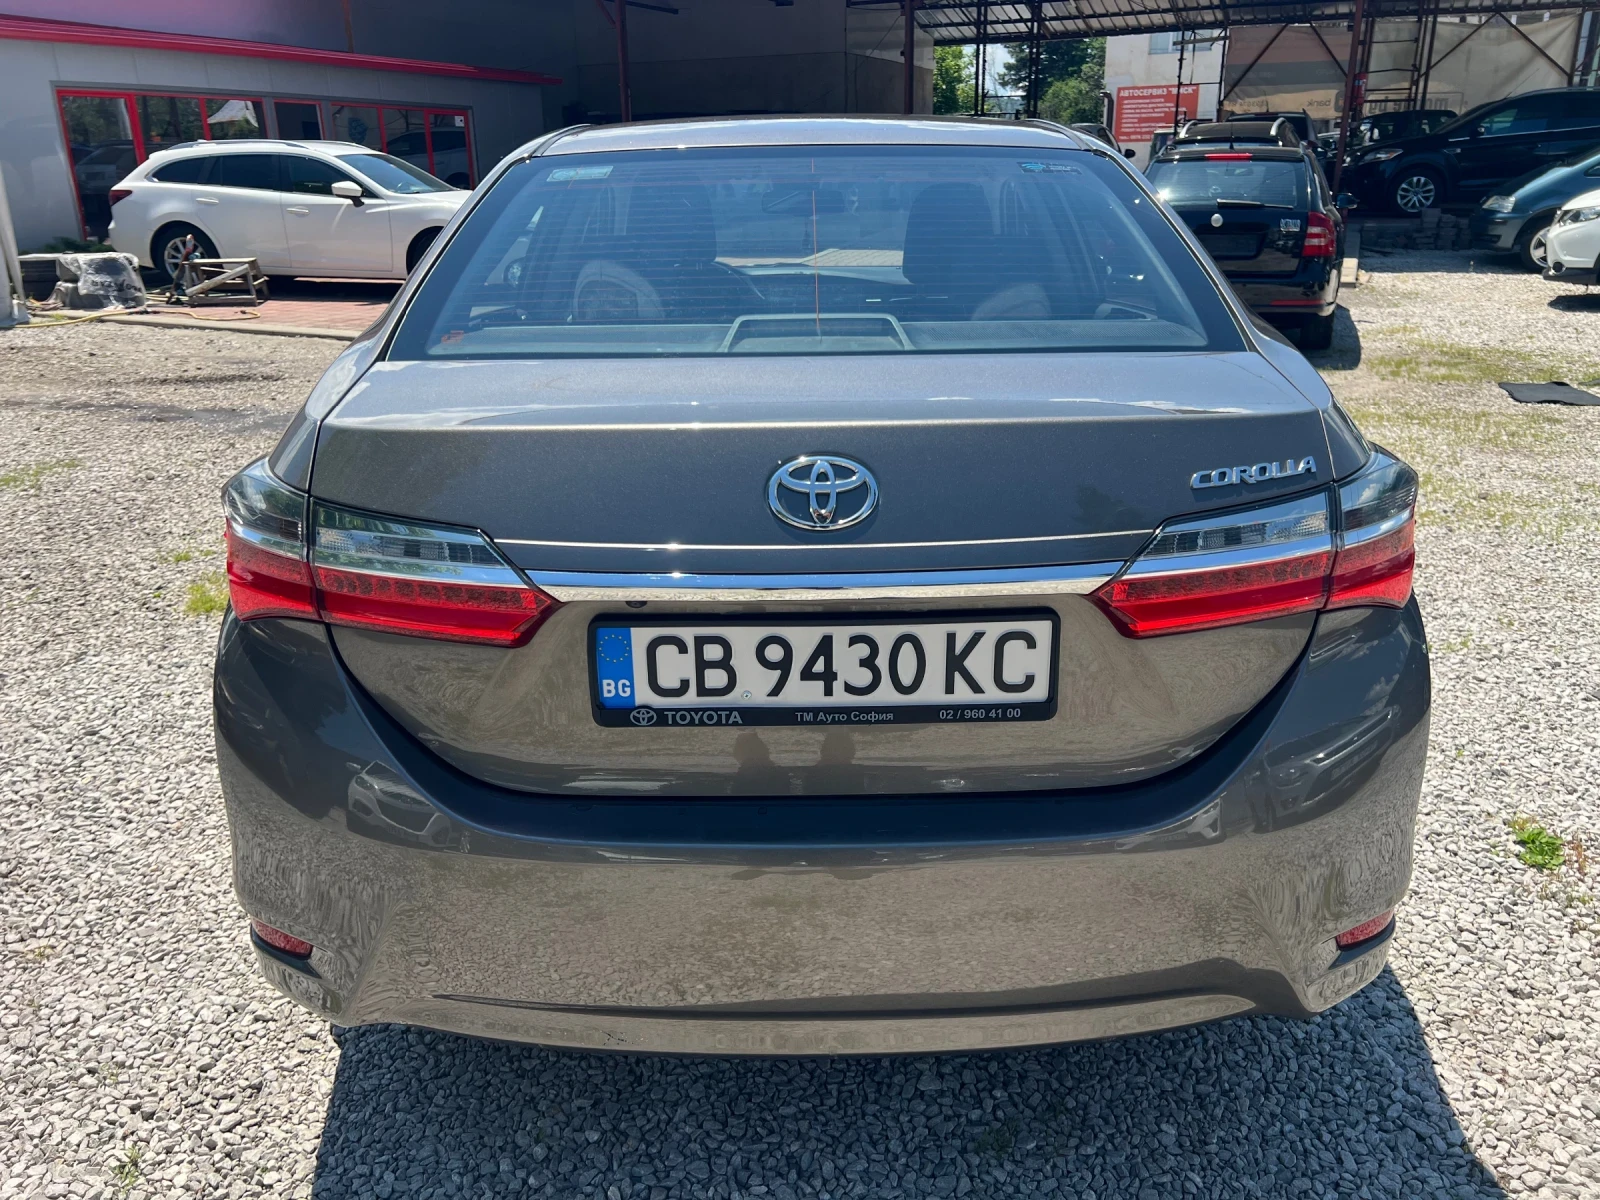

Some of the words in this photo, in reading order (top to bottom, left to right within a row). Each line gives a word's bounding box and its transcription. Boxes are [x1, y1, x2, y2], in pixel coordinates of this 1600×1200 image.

[1119, 88, 1167, 97] АВТОСЕРВИЗ
[1190, 456, 1317, 489] COROLLA
[645, 635, 738, 697] CB
[755, 633, 927, 697] 9430
[602, 679, 631, 698] BG
[664, 711, 743, 725] TOYOTA
[817, 712, 847, 723] Ауто
[850, 711, 895, 723] София
[939, 709, 953, 720] 02
[964, 708, 986, 719] 960
[988, 708, 1003, 719] 41
[1007, 707, 1022, 718] 00
